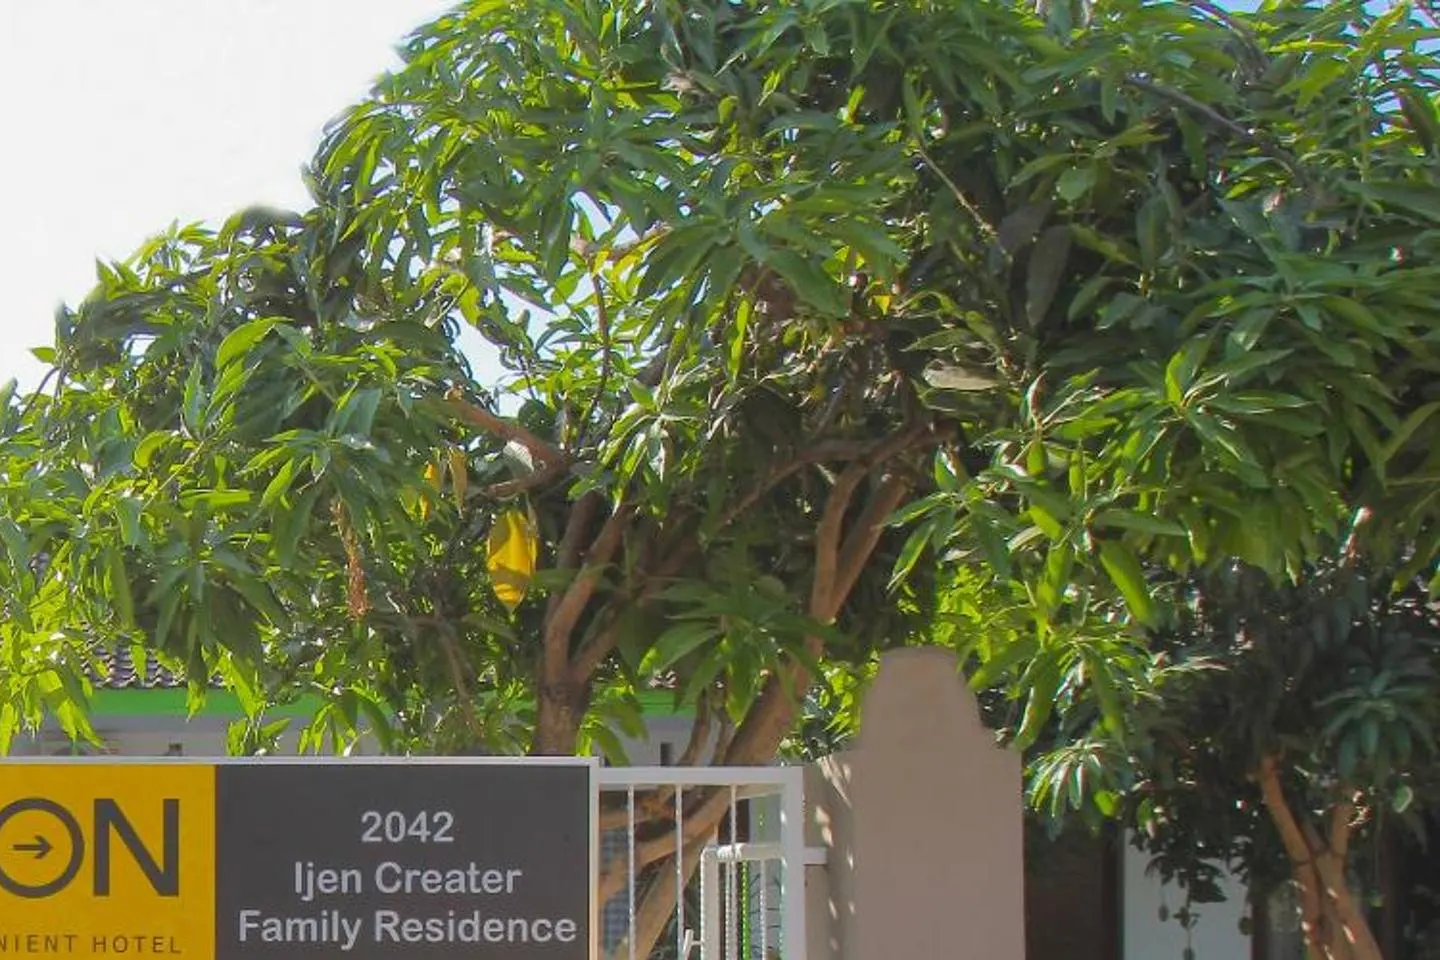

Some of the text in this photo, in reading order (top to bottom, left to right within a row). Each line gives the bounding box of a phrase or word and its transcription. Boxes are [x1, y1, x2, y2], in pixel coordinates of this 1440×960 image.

[361, 811, 455, 842] 2042
[295, 861, 522, 903] Ijen Creater
[91, 933, 183, 955] HOTEL
[239, 910, 577, 951] Family Residence
